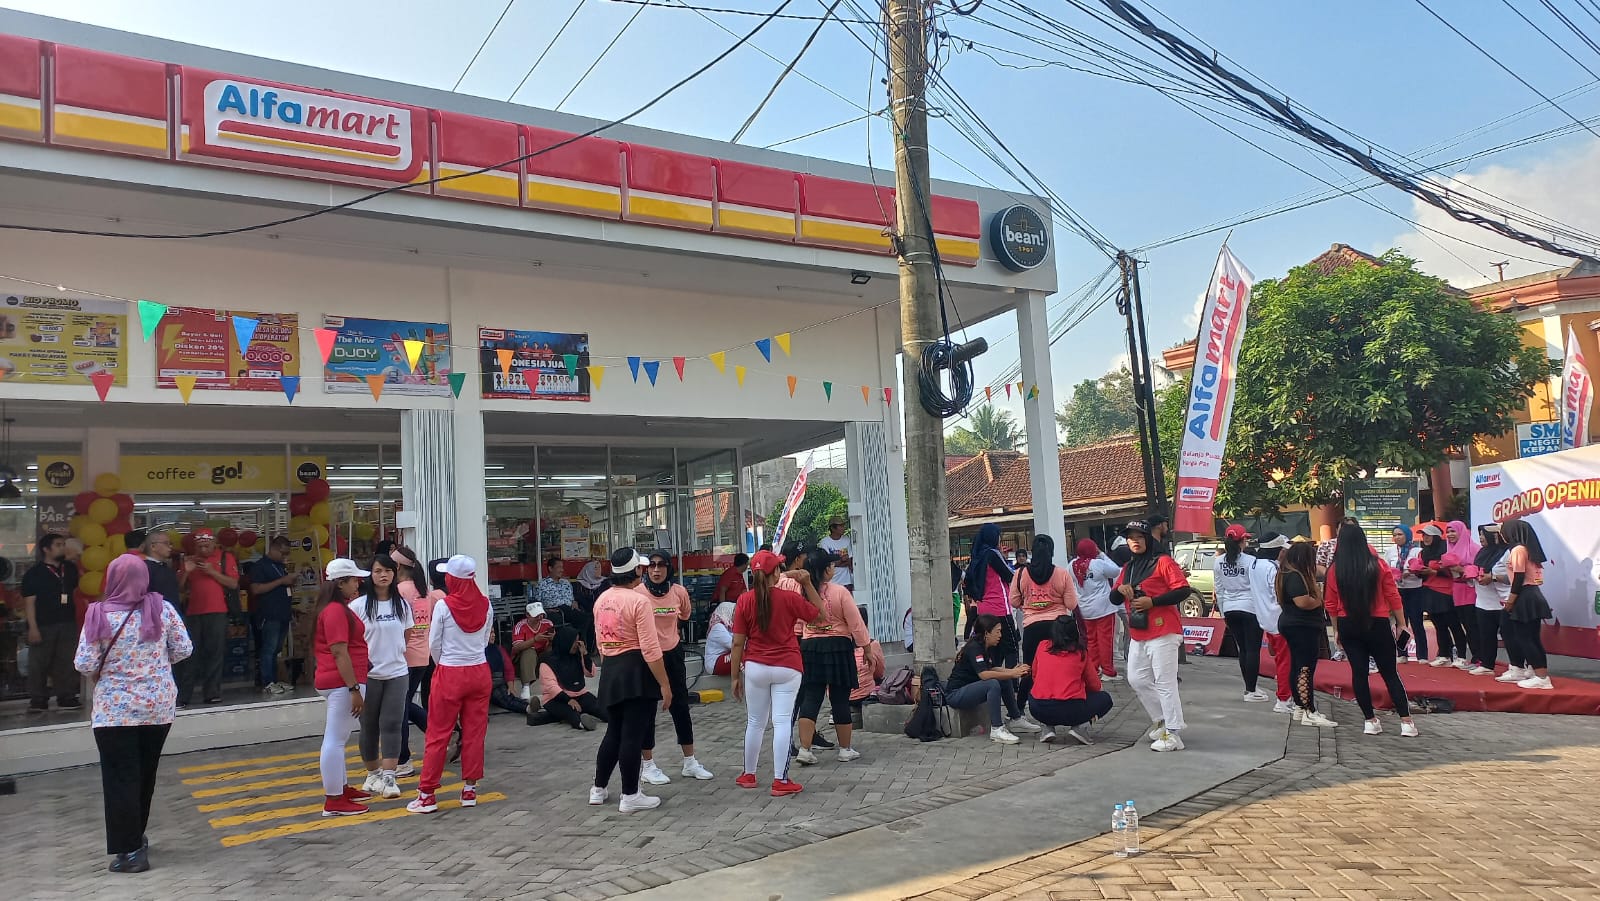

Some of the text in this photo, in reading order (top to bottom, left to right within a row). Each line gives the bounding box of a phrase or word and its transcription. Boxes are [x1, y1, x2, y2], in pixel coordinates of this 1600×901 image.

[217, 84, 401, 140] Alfamart
[1005, 224, 1044, 247] bean!
[337, 335, 353, 343] The
[493, 358, 547, 369] IONESIA
[1188, 274, 1237, 440] Alfamart
[1530, 422, 1560, 438] SM
[147, 467, 196, 480] coffee
[211, 460, 243, 485] go!
[1475, 472, 1500, 484] Alfamart
[40, 505, 55, 514] LA
[1493, 488, 1542, 521] GRAND
[1183, 627, 1210, 637] amart
